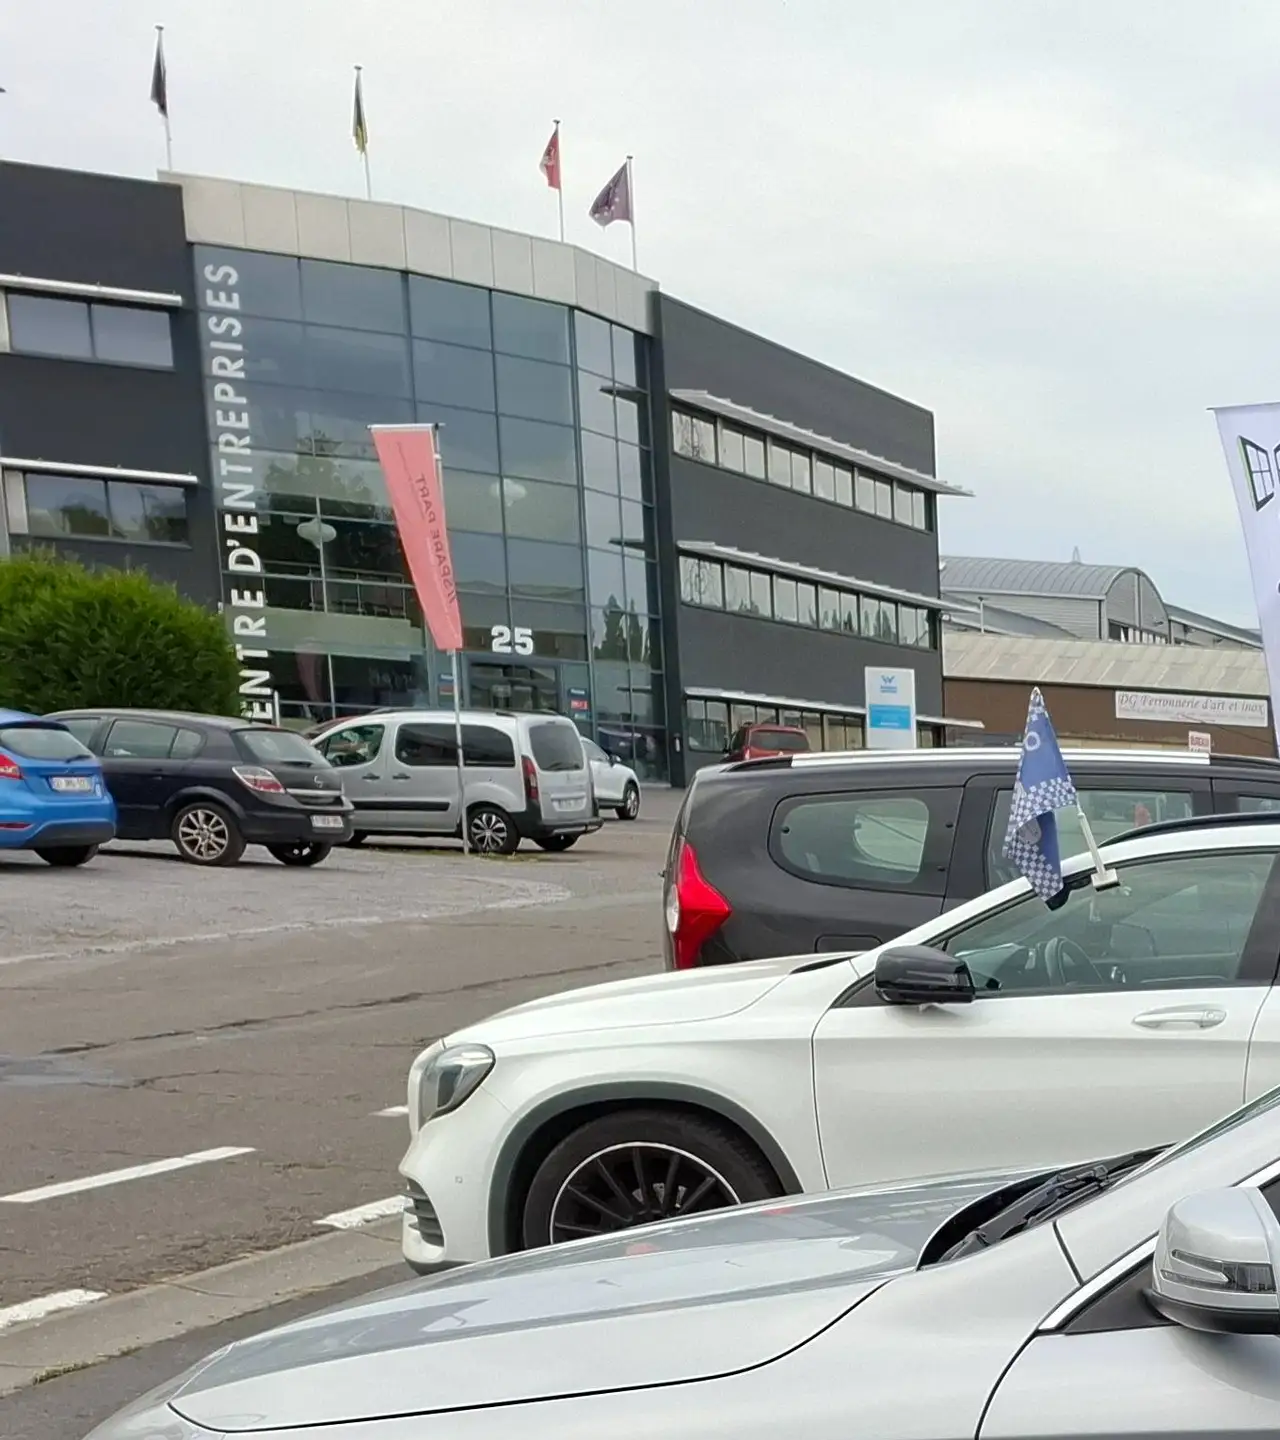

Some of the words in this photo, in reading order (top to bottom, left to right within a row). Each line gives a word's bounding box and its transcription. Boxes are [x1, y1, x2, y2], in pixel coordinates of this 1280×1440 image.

[204, 263, 263, 573] D'ENTREPRISES
[231, 588, 273, 721] ENTRE
[490, 624, 534, 656] 25
[1141, 695, 1200, 709] Ferronnerie
[1202, 699, 1226, 711] d'art
[1229, 701, 1239, 711] et
[1241, 703, 1266, 715] inox
